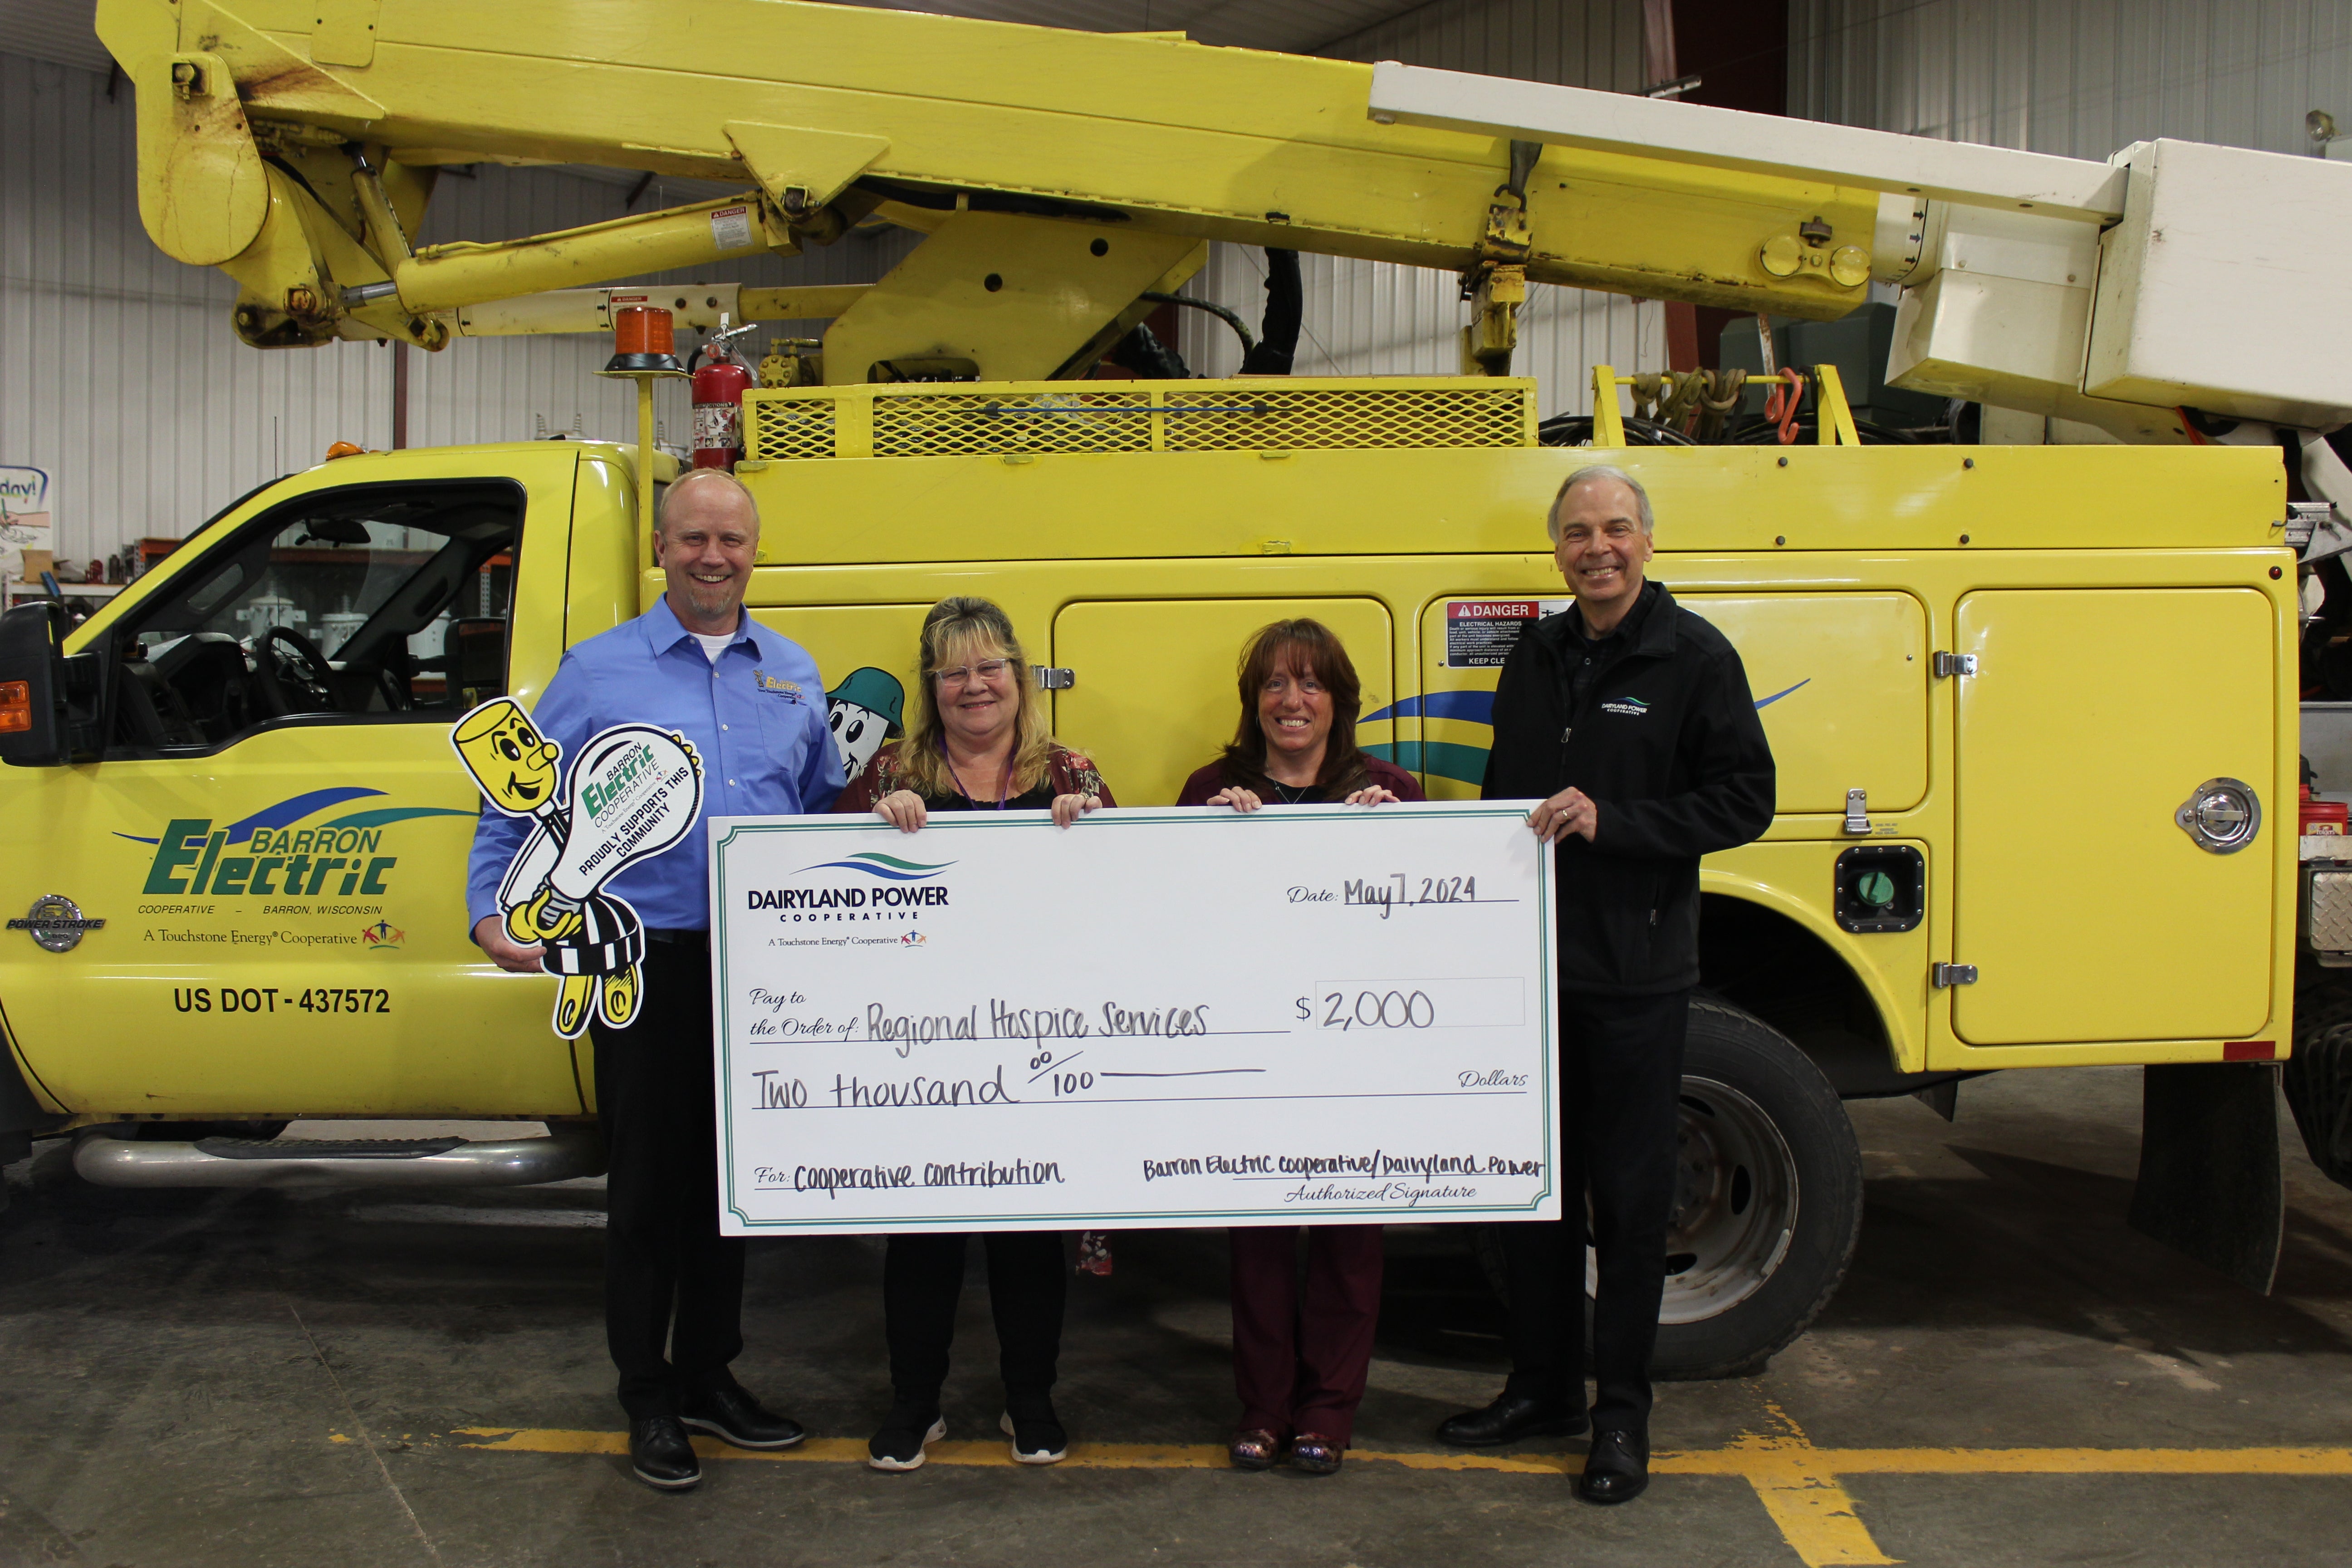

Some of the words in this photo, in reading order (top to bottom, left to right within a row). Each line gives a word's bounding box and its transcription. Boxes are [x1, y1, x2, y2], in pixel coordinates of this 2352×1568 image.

[720, 207, 745, 216] DANGER
[1473, 605, 1529, 617] DANGER
[766, 676, 802, 692] Electric
[606, 742, 642, 781] BARRON
[581, 744, 654, 820] Electric
[595, 759, 659, 828] COOPERATIVE
[604, 813, 624, 831] Touchstone
[635, 780, 657, 801] Cooperative
[579, 833, 622, 876] PROUDLY
[620, 788, 668, 835] SUPPORTS
[665, 767, 689, 789] THIS
[616, 802, 670, 858] COMMUNITY
[250, 829, 381, 853] BARRON
[142, 819, 397, 896] Electric
[748, 888, 866, 909] DAIRYLAND
[872, 887, 949, 906] POWER
[1287, 886, 1339, 903] Date:
[1344, 878, 1392, 919] May
[138, 906, 215, 914] COOPERATIVE
[263, 906, 312, 916] BARRON,
[316, 905, 382, 914] WISCONSIN
[780, 911, 918, 922] COOPERATIVE
[6, 920, 50, 928] POWER
[52, 920, 103, 928] STROKE
[144, 931, 155, 941] A
[158, 930, 227, 943] Touchstone
[281, 931, 357, 945] Cooperative
[852, 936, 898, 945] Cooperative
[174, 988, 211, 1013] US
[221, 989, 279, 1013] DOT
[299, 989, 390, 1013] 437572
[750, 988, 786, 1012] Pay
[791, 991, 806, 1004] to
[1296, 996, 1311, 1022] $
[1323, 990, 1434, 1031] 2,000
[750, 1019, 777, 1035] the
[781, 1018, 833, 1035] Order
[838, 1017, 858, 1042] of:
[867, 1003, 977, 1058] Regional
[990, 998, 1089, 1049] Hospice
[1098, 1001, 1209, 1038] Services
[752, 1070, 807, 1108] Two
[829, 1064, 1020, 1107] thousand
[1458, 1069, 1528, 1087] Dollars
[755, 1166, 790, 1183] For:
[1143, 1158, 1202, 1181] Barron
[1205, 1156, 1275, 1174] Electric
[1489, 1155, 1546, 1177] Power
[1284, 1183, 1392, 1203] Authorized
[1389, 1183, 1476, 1207] Signature
